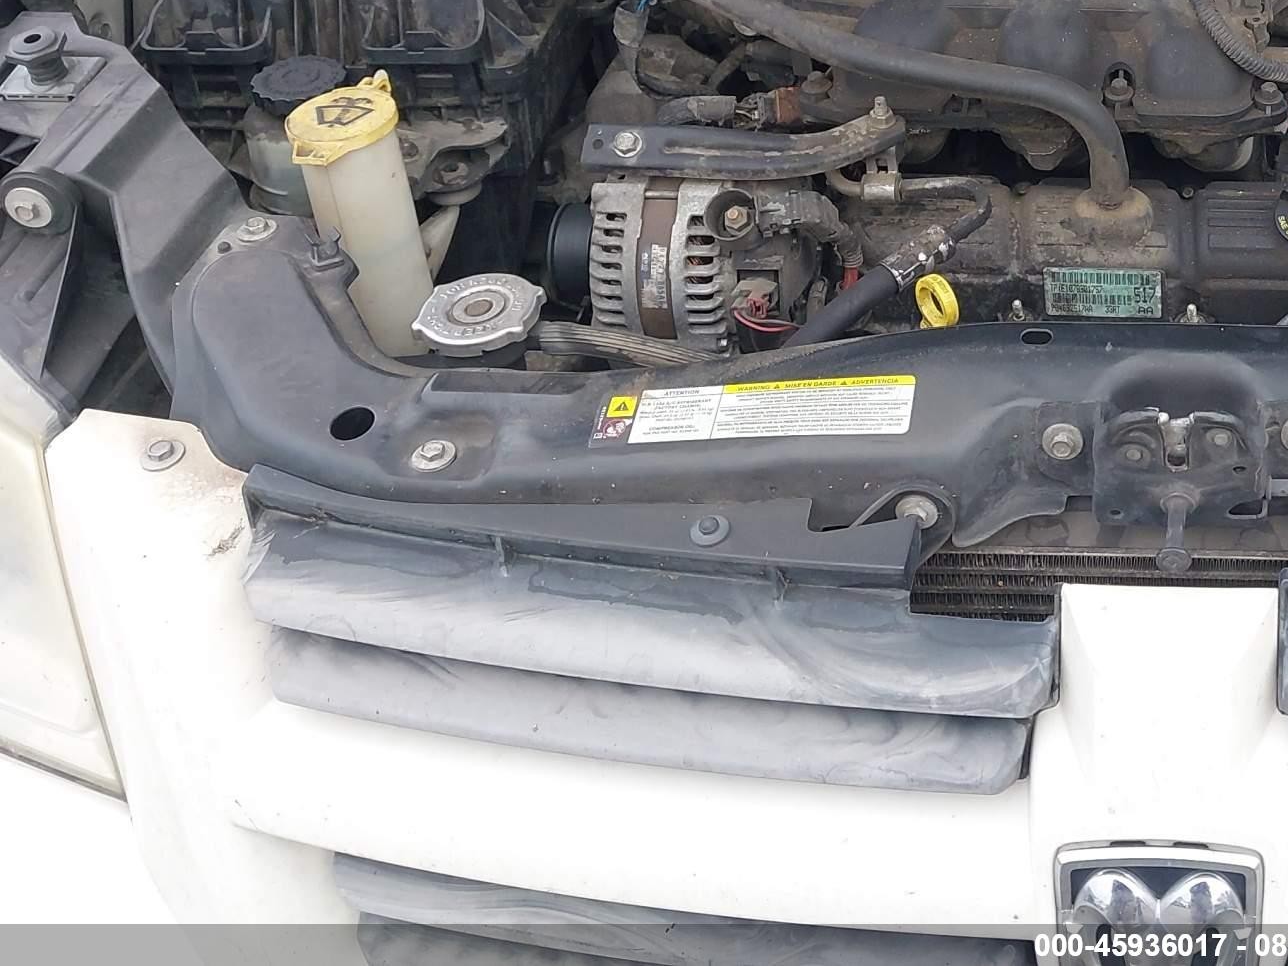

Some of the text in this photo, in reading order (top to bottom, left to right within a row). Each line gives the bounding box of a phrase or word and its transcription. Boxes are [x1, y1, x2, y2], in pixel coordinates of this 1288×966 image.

[1278, 215, 1288, 230] SAE
[1133, 287, 1156, 303] 517
[1137, 306, 1154, 314] AA
